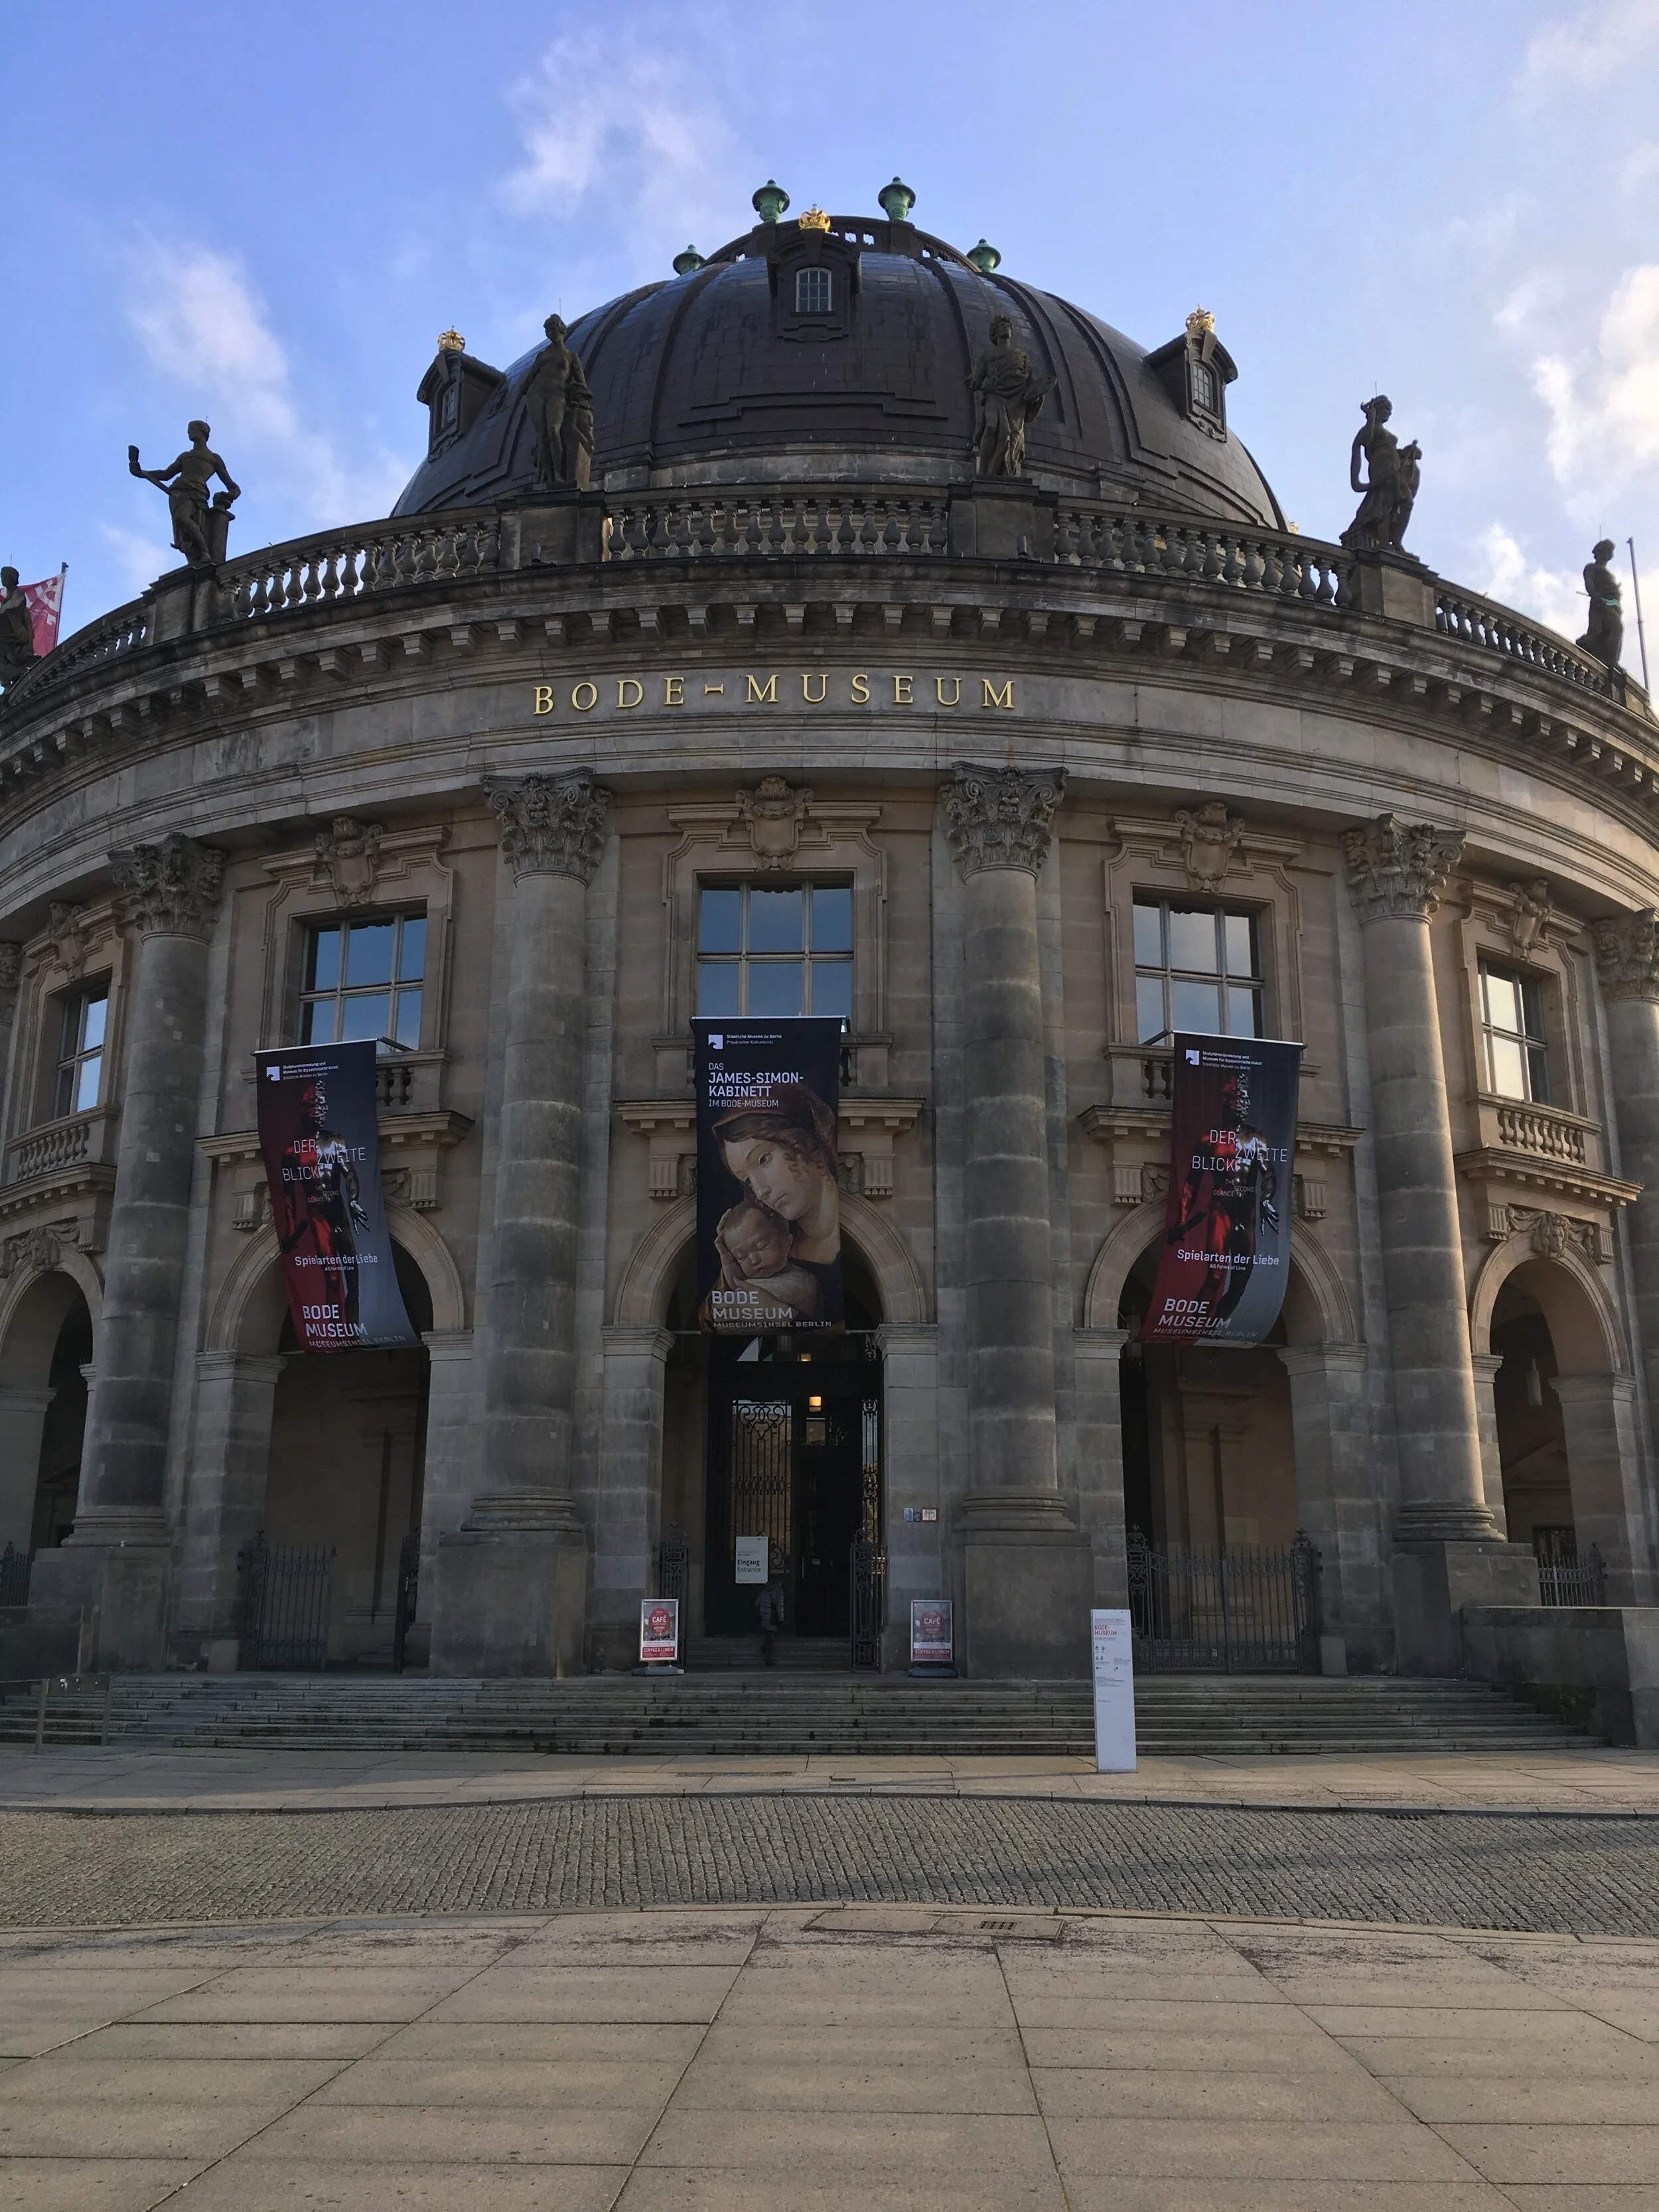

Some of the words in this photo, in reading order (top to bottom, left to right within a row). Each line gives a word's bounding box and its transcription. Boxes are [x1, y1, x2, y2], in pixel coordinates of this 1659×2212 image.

[532, 674, 1015, 715] BODE-MUSEUM
[708, 1072, 804, 1084] JAMES-SIMON-
[709, 1085, 772, 1097] KABINETT
[1210, 1130, 1236, 1144] DER
[293, 1139, 316, 1153] DER
[317, 1147, 366, 1165] ZWEITE
[1235, 1147, 1287, 1162] ZWEITE
[1192, 1155, 1235, 1172] BLICK
[282, 1166, 319, 1181] BLICK
[295, 1255, 341, 1267] Spielarten
[342, 1254, 355, 1264] der
[356, 1253, 378, 1264] Liebe
[1177, 1249, 1231, 1263] Spielarten
[1234, 1253, 1250, 1264] der
[1253, 1254, 1279, 1265] Liebe
[711, 1290, 759, 1304] BODE
[302, 1304, 340, 1319] BODE
[1164, 1298, 1210, 1314] BODE
[713, 1307, 793, 1320] MUSEUM
[1158, 1314, 1232, 1329] MUSEUM
[305, 1323, 368, 1337] MUSEUM
[1153, 1328, 1223, 1337] MUSEUMSINSEL
[309, 1339, 373, 1348] MUSEUMSINSEL
[374, 1335, 406, 1345] BERLIN
[924, 1616, 940, 1625] CAFÉ
